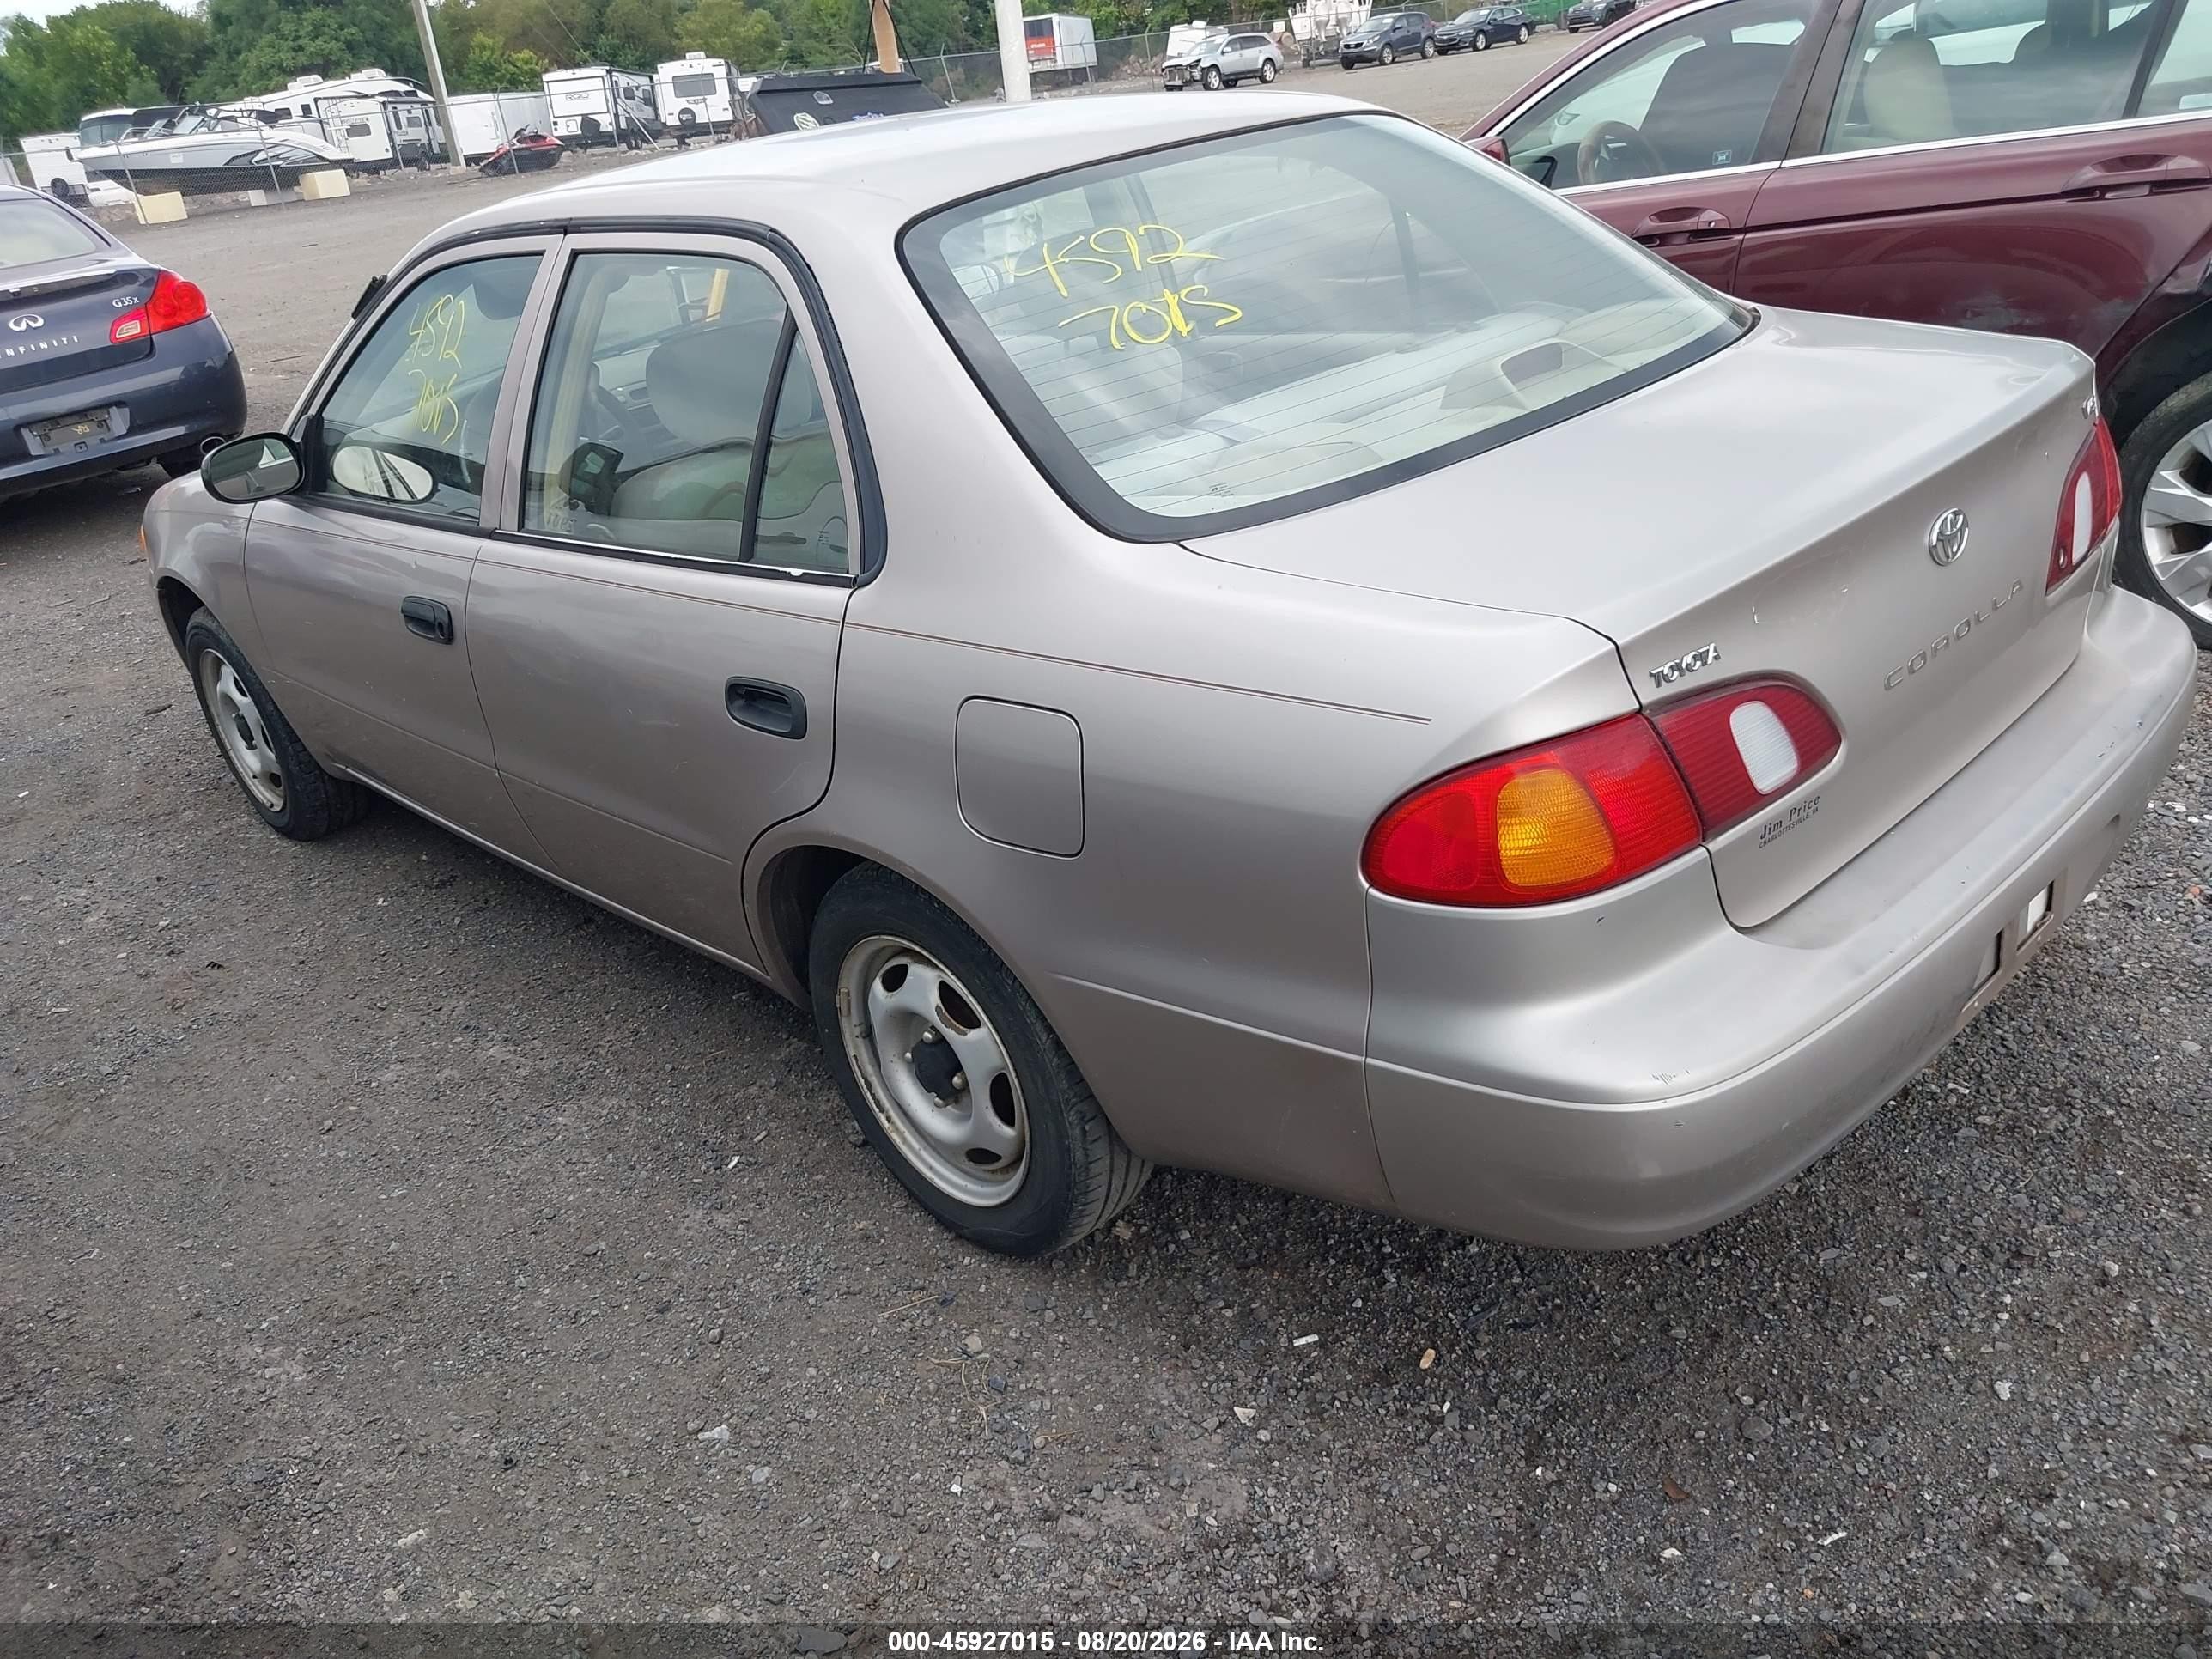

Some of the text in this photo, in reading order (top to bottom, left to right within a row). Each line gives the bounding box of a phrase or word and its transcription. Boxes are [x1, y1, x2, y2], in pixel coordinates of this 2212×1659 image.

[1004, 224, 1225, 298] 4592
[112, 296, 140, 308] G35x
[1057, 284, 1243, 350] 7015
[1884, 578, 2023, 691] COROLLA
[1649, 642, 1722, 688] TOYOTA
[1760, 795, 1820, 839] Jim Price
